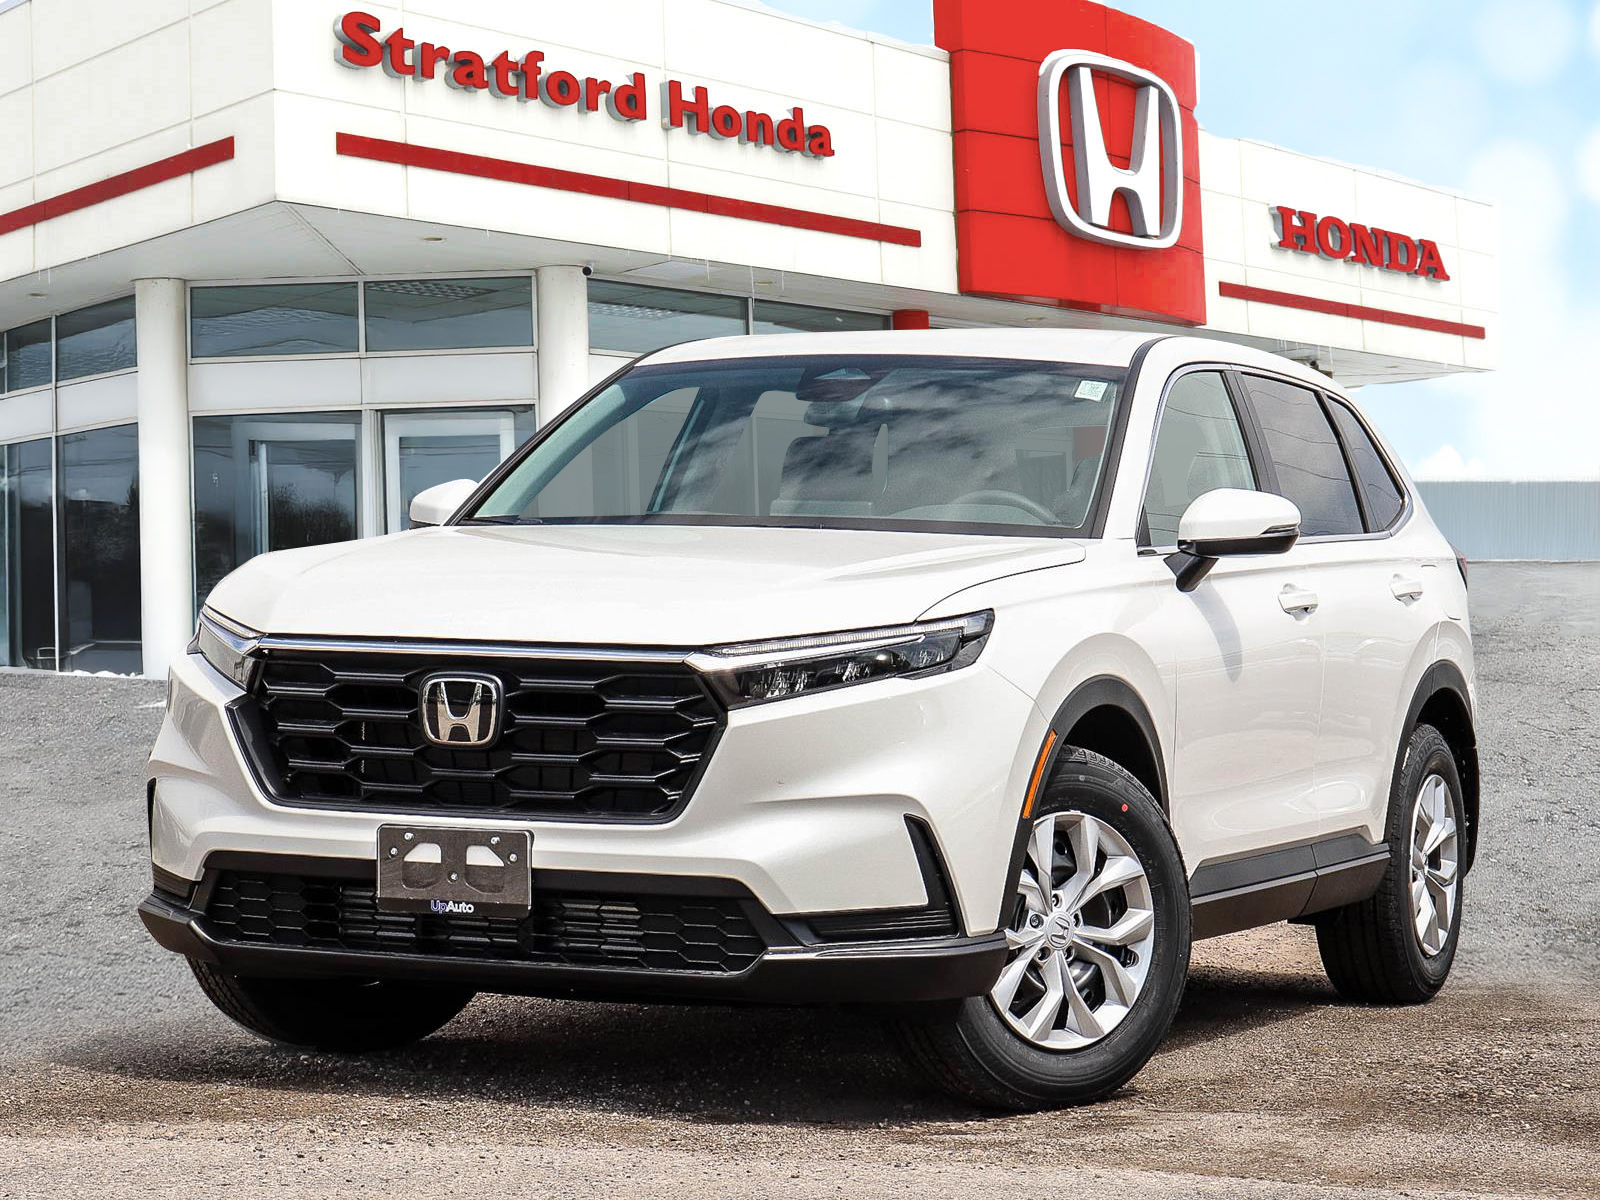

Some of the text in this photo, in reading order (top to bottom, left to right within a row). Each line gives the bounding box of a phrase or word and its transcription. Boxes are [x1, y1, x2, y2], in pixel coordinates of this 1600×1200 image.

[340, 11, 835, 157] Stratford Honda
[1275, 205, 1451, 281] HONDA
[430, 899, 475, 914] UpAuto
